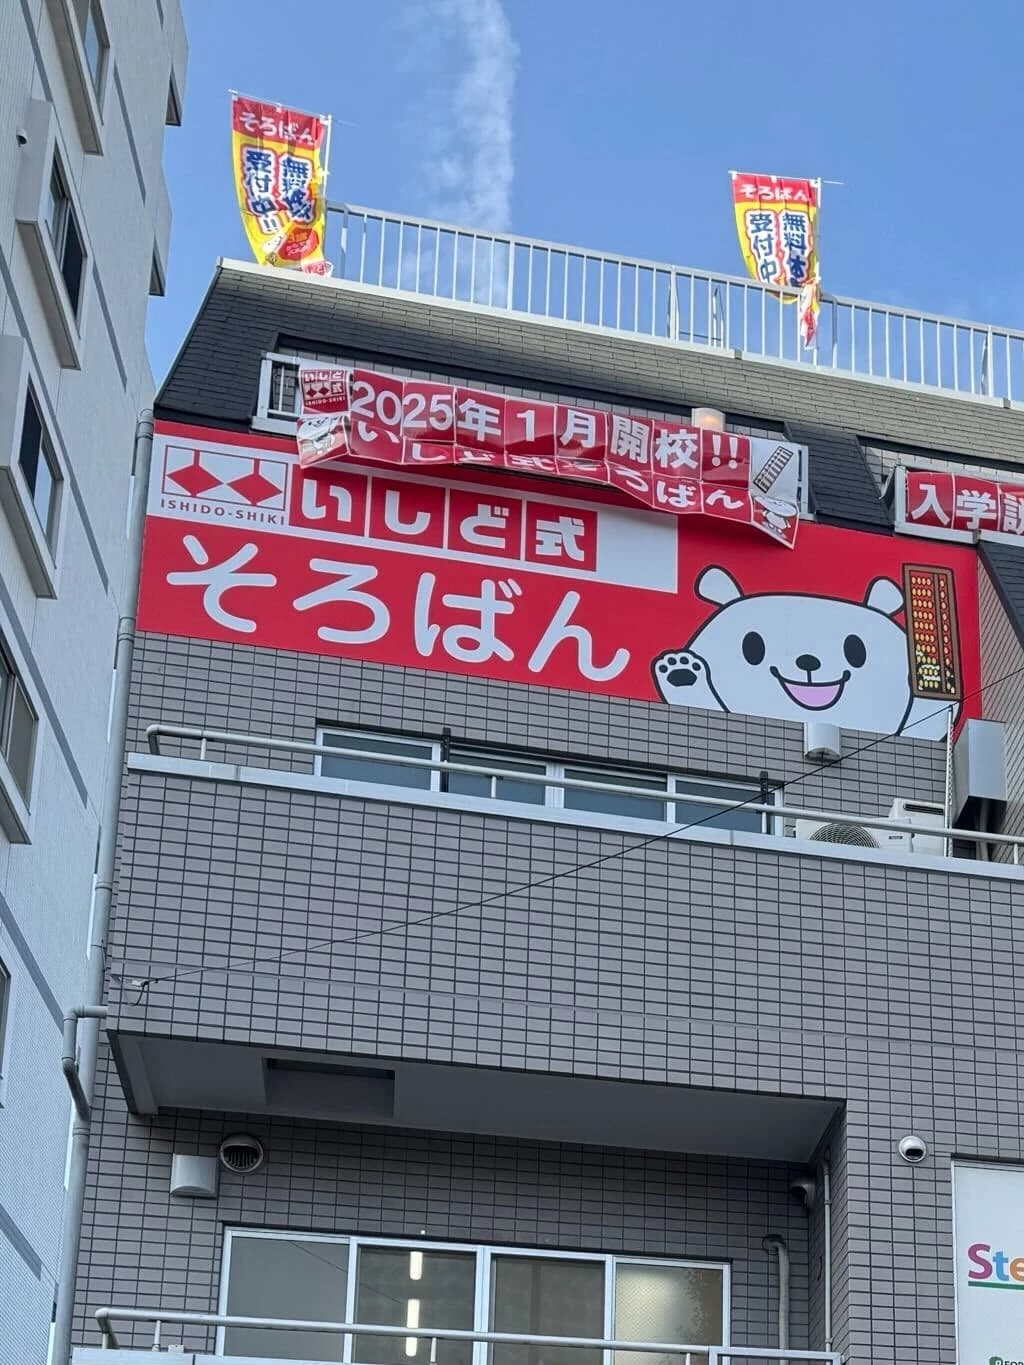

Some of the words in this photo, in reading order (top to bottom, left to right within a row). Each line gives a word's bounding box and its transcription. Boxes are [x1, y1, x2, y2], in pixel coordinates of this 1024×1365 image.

[239, 110, 315, 146] そろばん
[739, 183, 808, 201] そろばん
[160, 498, 285, 526] ISHIDO-SHIKI
[300, 477, 586, 563] いしど式
[166, 534, 631, 682] そろばん
